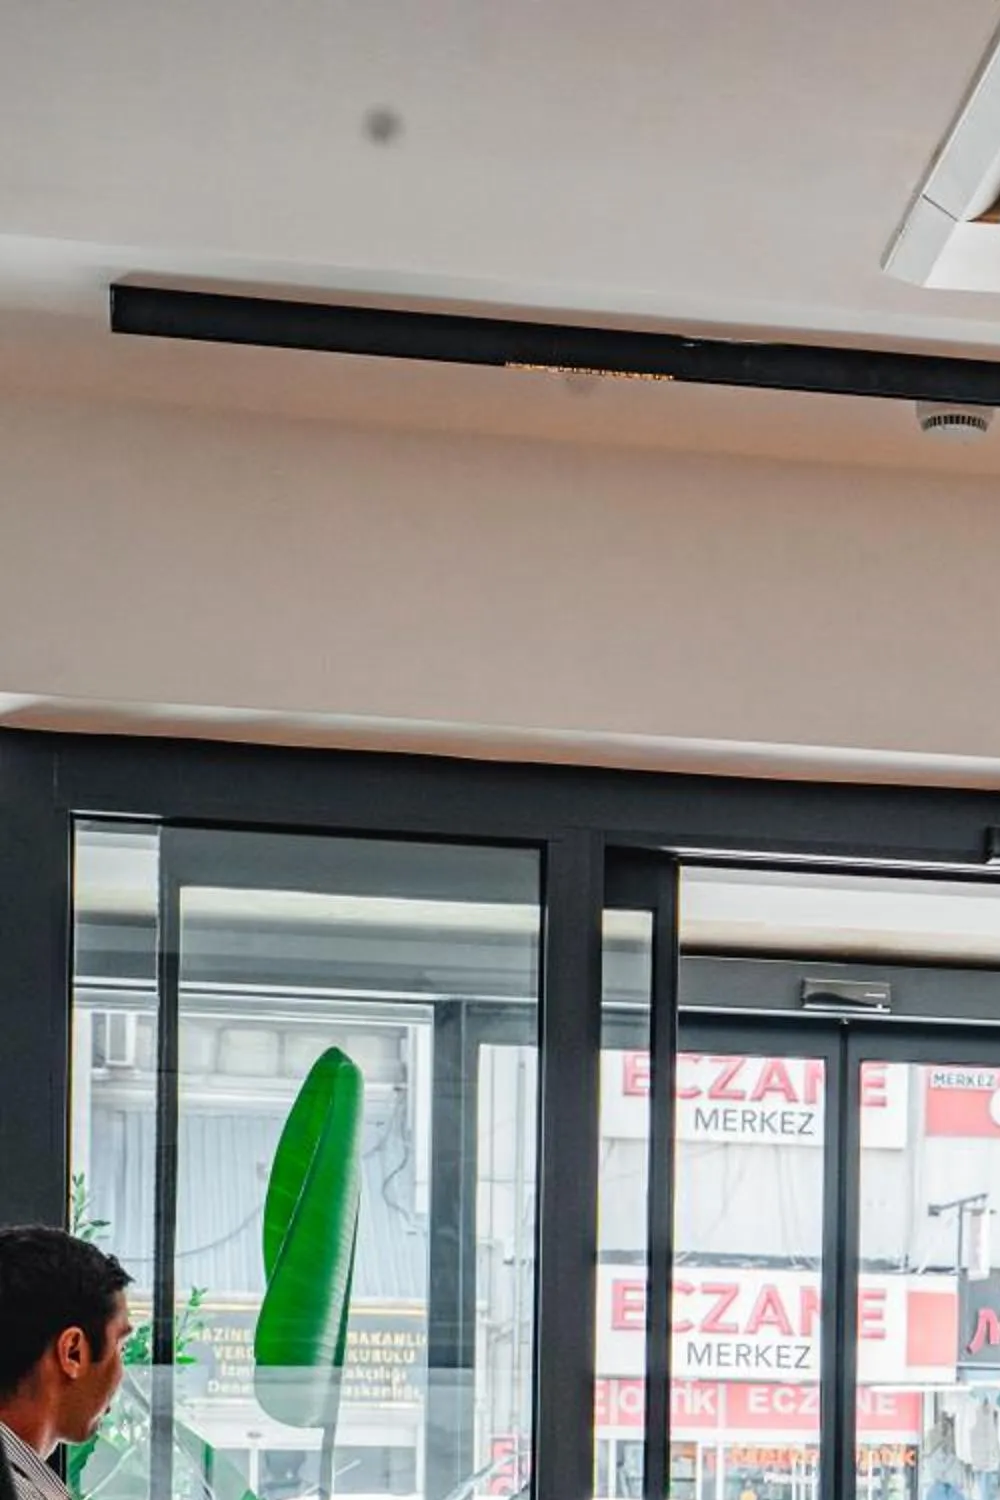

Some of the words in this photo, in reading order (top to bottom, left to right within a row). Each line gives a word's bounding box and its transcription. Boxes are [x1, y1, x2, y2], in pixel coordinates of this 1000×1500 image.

[934, 1073, 996, 1087] MERKEZ
[694, 1107, 815, 1135] MERKEZ
[687, 1341, 812, 1369] MERKEZ
[748, 1386, 899, 1416] ECZNE
